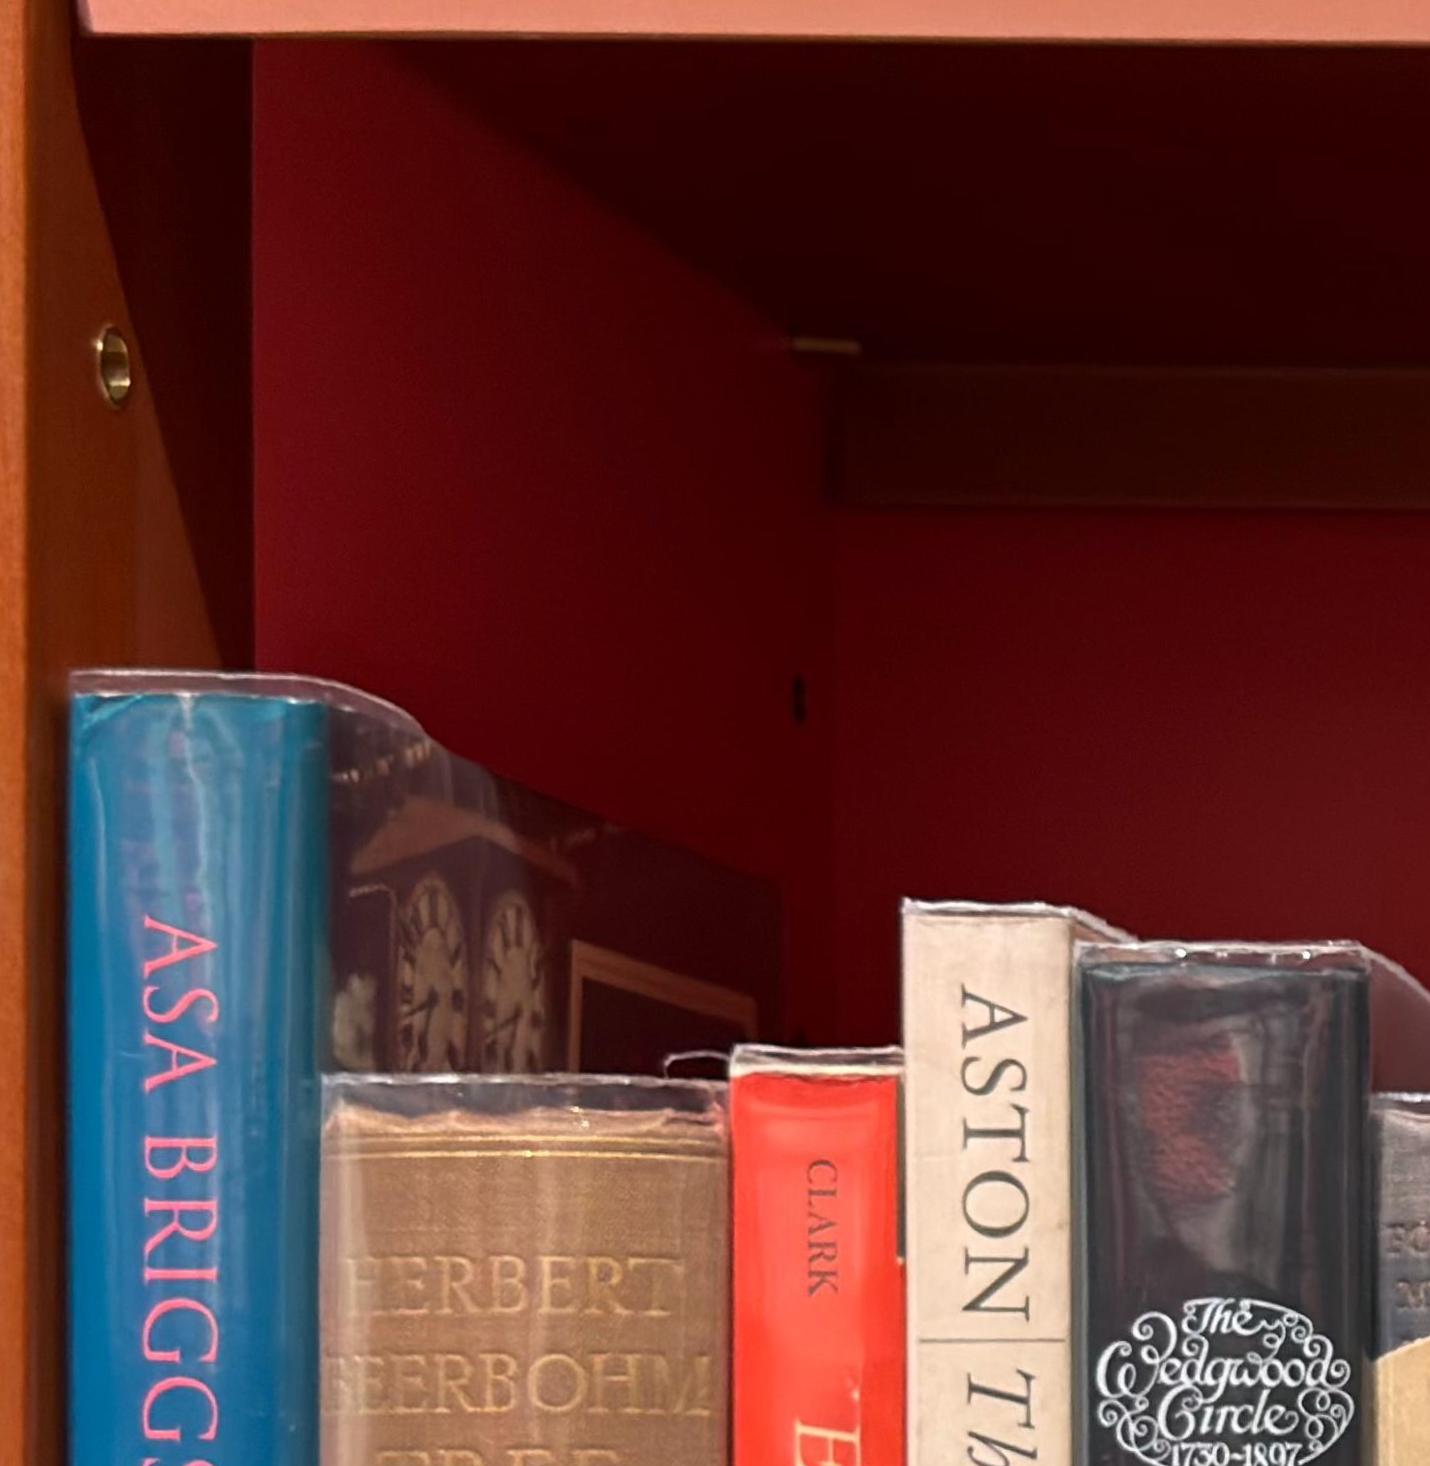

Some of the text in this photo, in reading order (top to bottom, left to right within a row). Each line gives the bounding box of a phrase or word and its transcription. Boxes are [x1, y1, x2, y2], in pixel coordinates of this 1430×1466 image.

[142, 916, 218, 1092] ASA
[960, 984, 1030, 1322] ASTON
[806, 1159, 839, 1296] CLARK
[346, 1255, 684, 1315] HERBERT
[1182, 1298, 1262, 1335] The
[325, 1353, 713, 1414] BEERBOHM
[1097, 1312, 1345, 1404] Wedgwood
[1158, 1385, 1299, 1440] Circle
